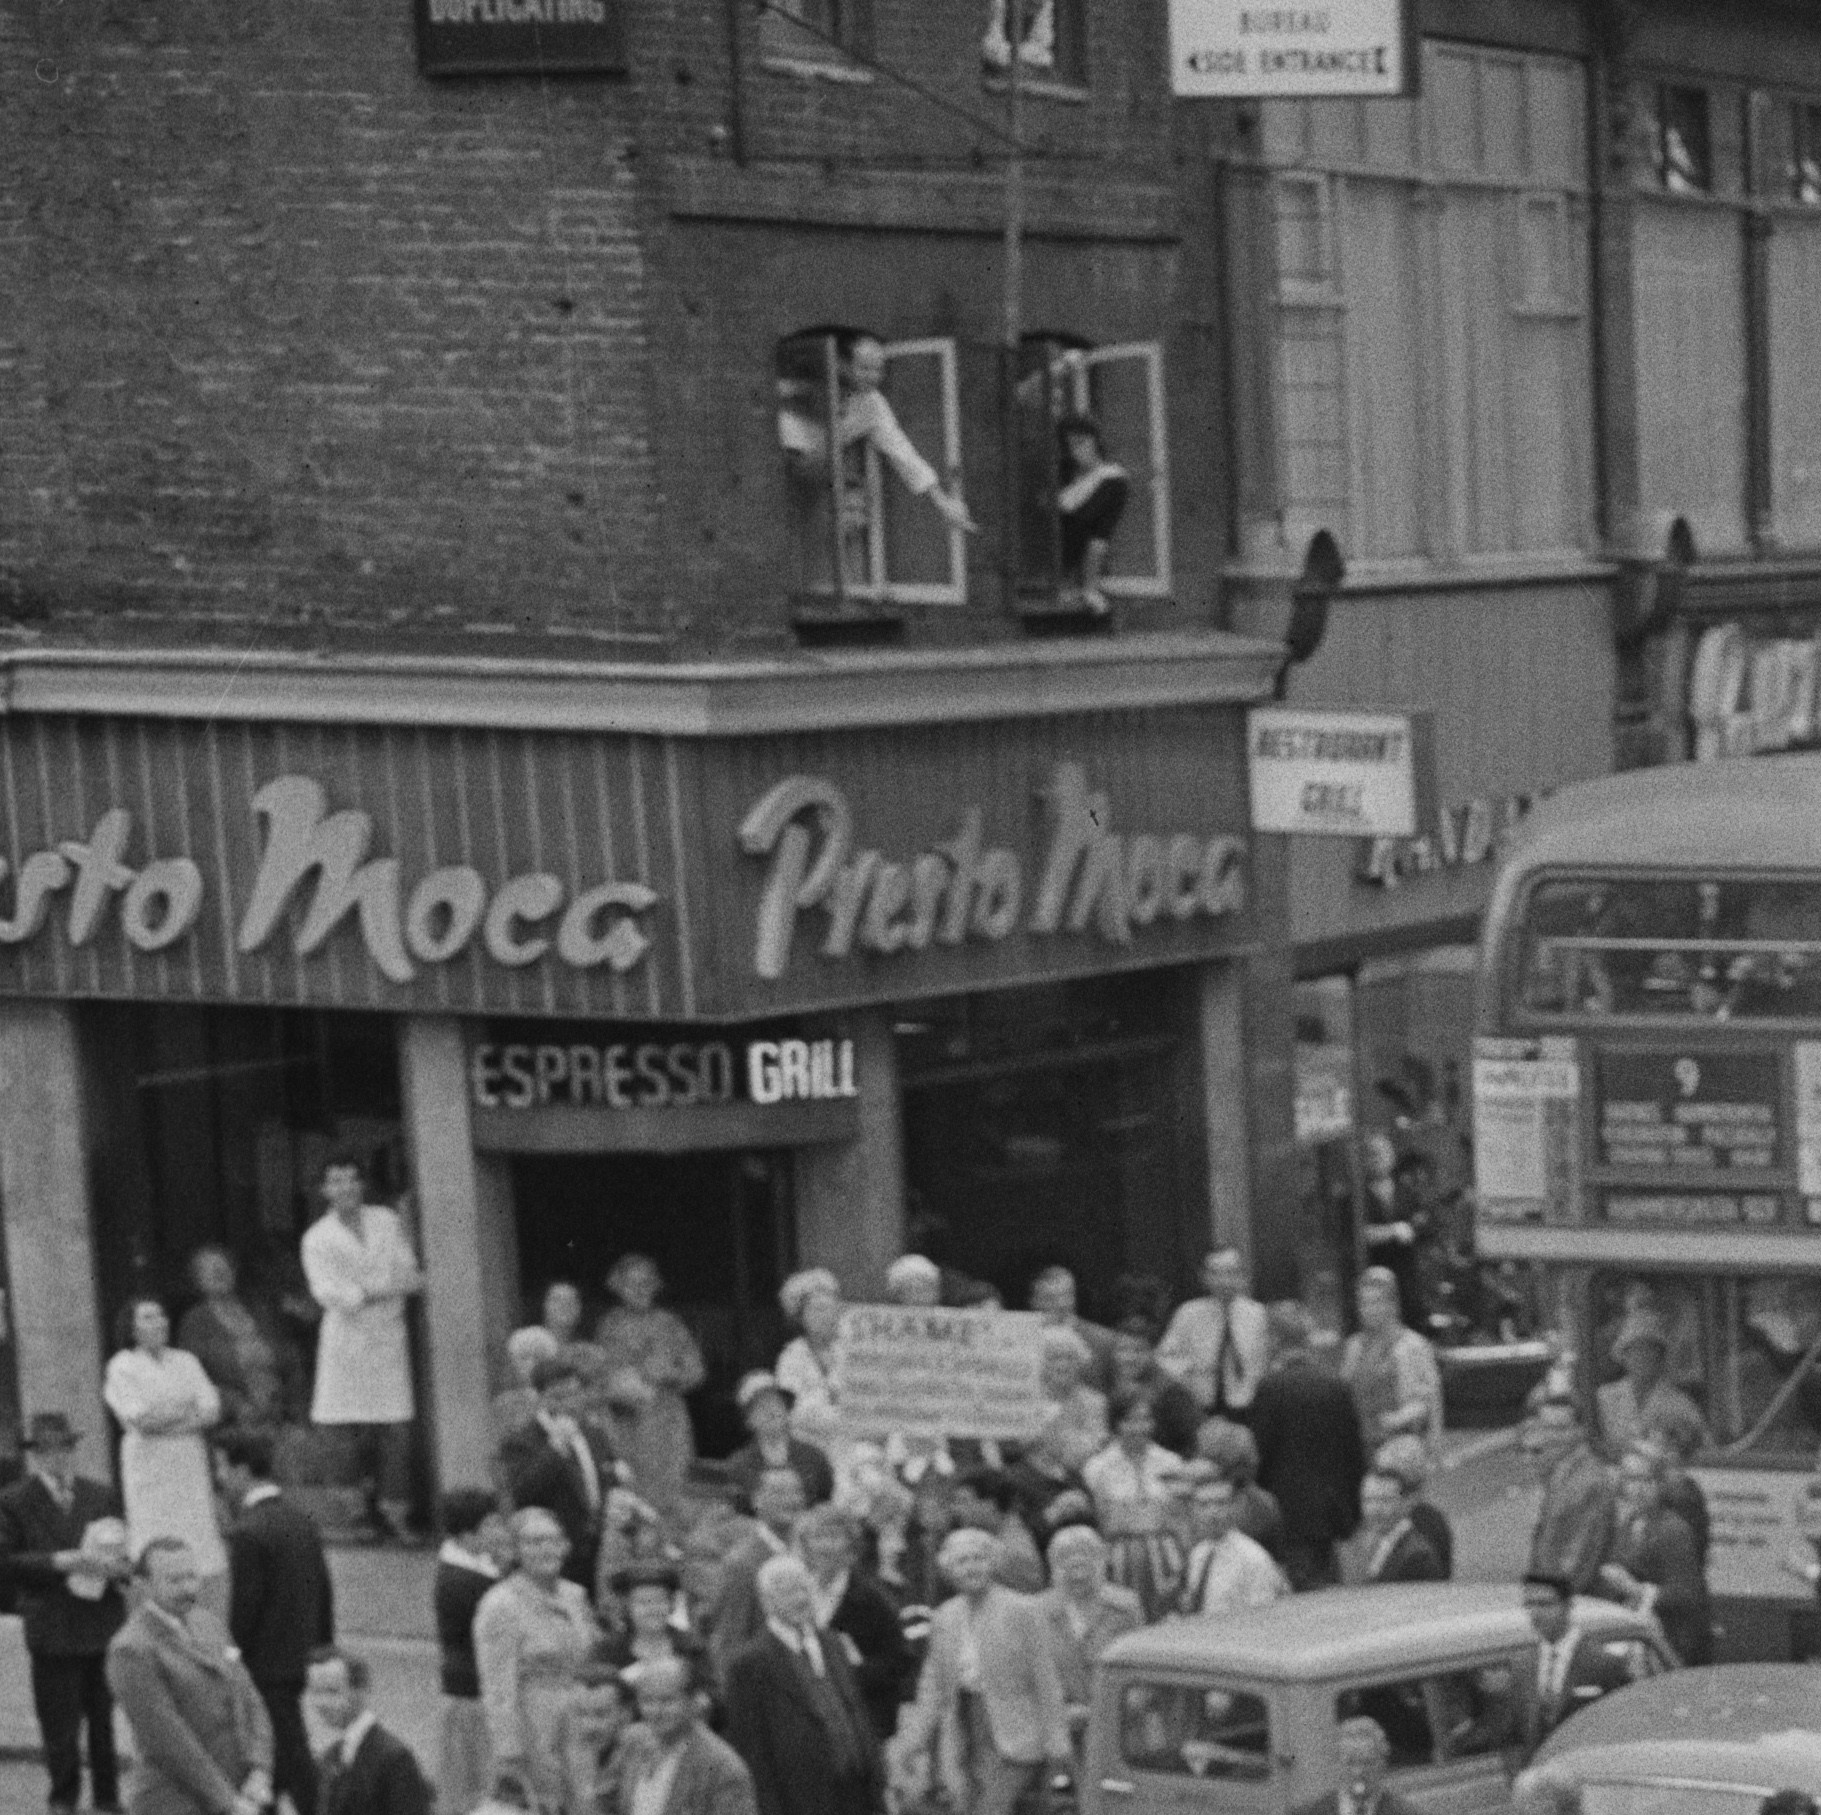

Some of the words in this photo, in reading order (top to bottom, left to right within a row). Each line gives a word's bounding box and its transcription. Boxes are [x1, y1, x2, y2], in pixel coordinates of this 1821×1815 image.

[238, 774, 659, 983] Moca
[738, 775, 1020, 980] Presto
[1036, 761, 1248, 944] Moca
[472, 1042, 734, 1109] ESPRESSO
[746, 1038, 859, 1104] GRILL
[1673, 1056, 1700, 1097] 9
